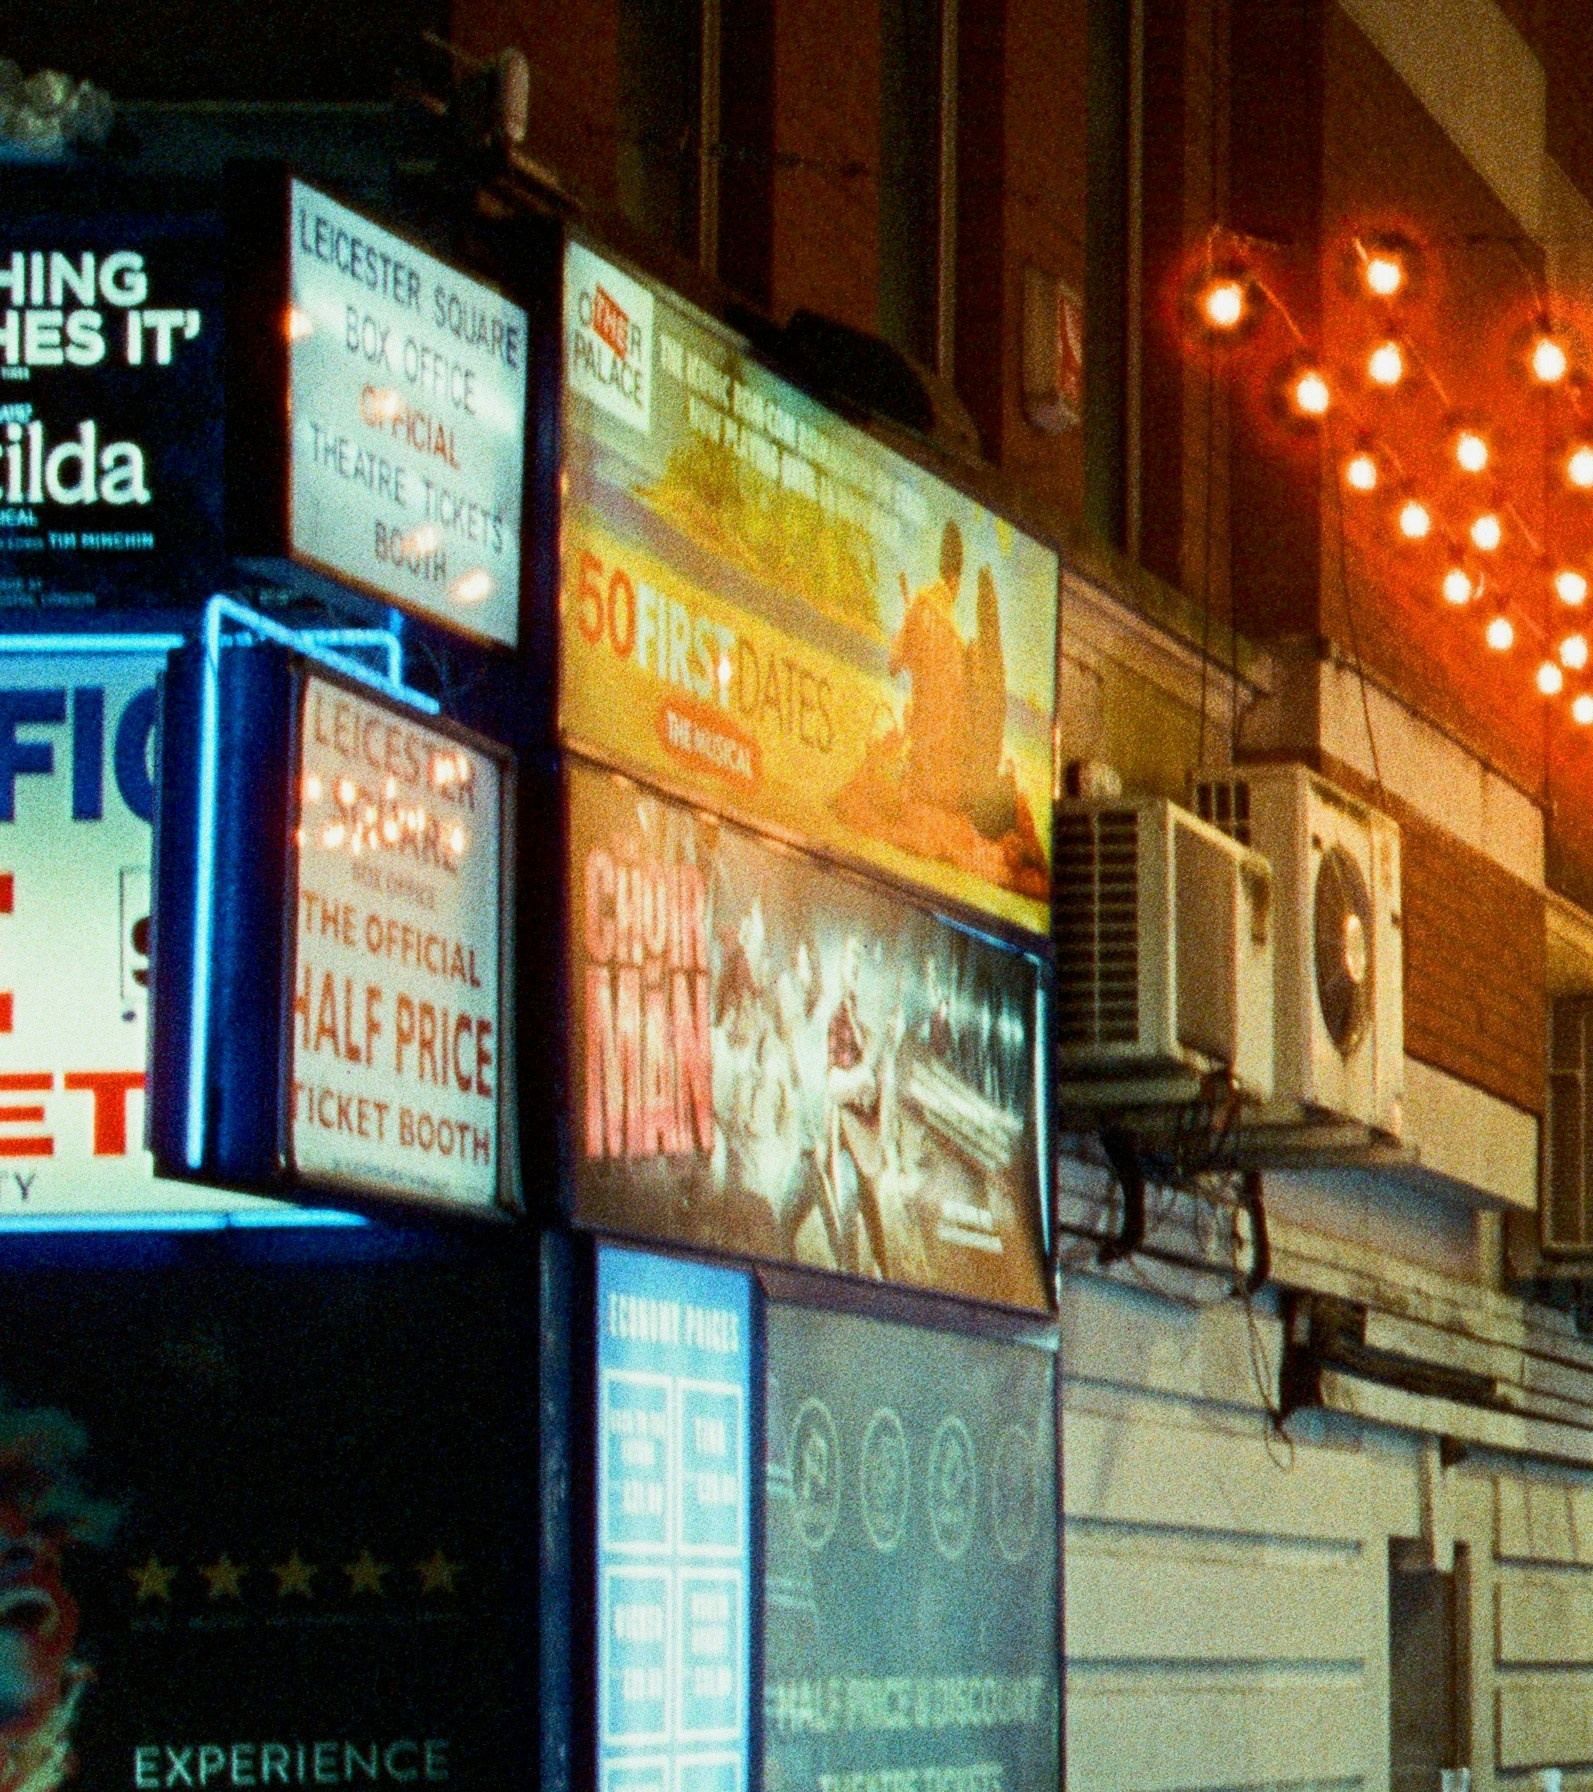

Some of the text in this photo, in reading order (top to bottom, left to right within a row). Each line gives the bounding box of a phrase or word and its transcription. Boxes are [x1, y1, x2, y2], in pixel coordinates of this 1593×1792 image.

[300, 211, 519, 373] LEICESTER SQUARE
[345, 306, 477, 415] BOX OFFICE
[574, 330, 644, 409] PALACE
[0, 419, 151, 504] ilda
[310, 422, 503, 556] THEATRE TICKETS
[578, 554, 833, 753] 50 FIRST DATES
[314, 692, 474, 811] LEICESTR
[304, 892, 481, 989] THE OFFICIAL
[294, 963, 493, 1099] HALF PRICE
[292, 1080, 492, 1167] TICKET BOOTH
[134, 1740, 450, 1788] EXPERIENCE
